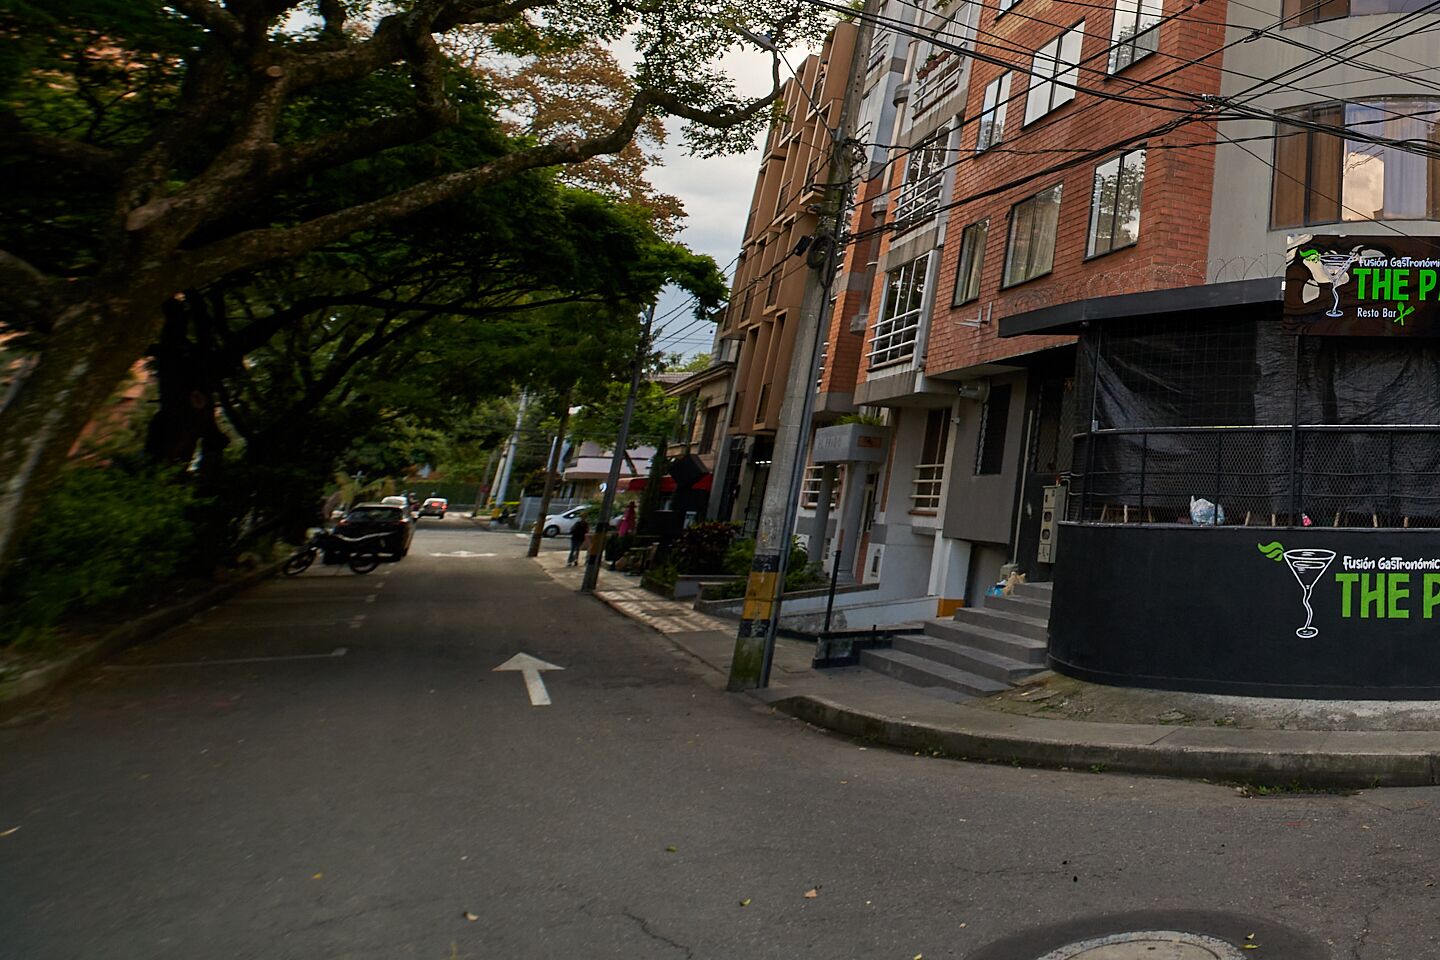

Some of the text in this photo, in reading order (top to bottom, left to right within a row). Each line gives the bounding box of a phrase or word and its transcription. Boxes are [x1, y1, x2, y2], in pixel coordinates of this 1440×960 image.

[1353, 268, 1410, 301] THE
[1357, 307, 1397, 319] Resto Bar
[1342, 555, 1375, 571] Fusión
[1335, 573, 1410, 619] THE
